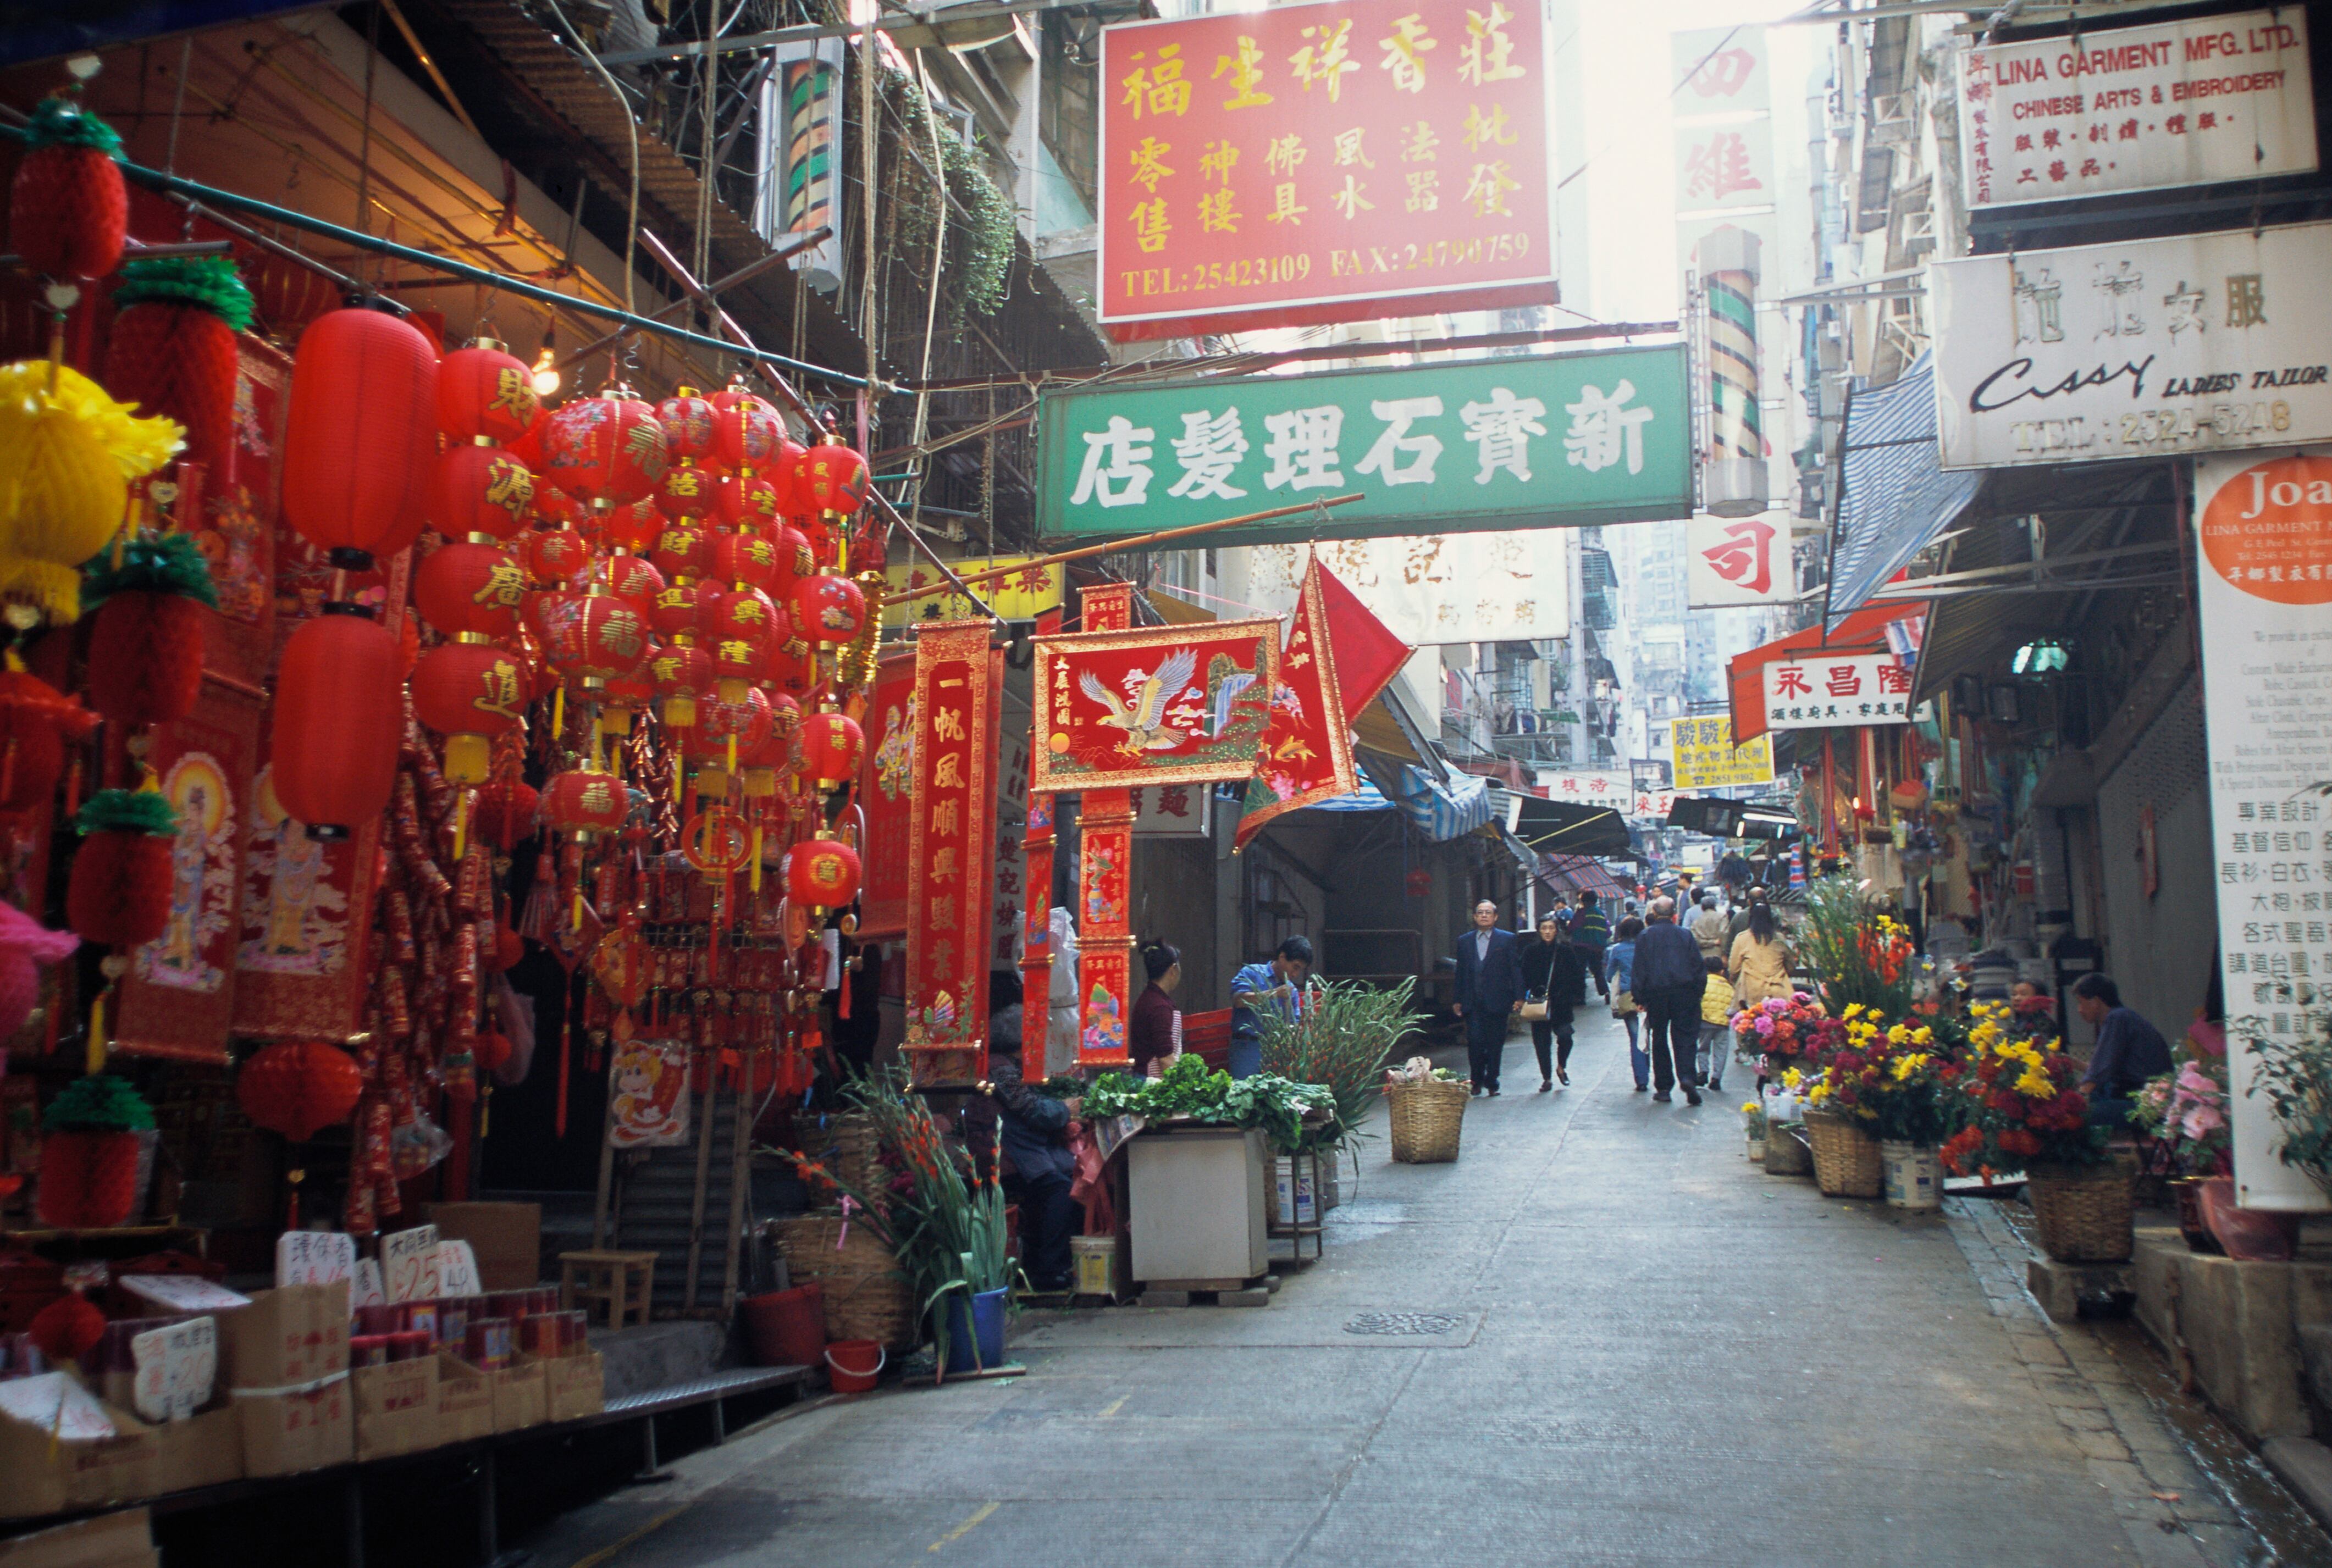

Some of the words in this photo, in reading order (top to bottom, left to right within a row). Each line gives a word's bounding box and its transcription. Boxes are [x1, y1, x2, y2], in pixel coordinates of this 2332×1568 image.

[1121, 1, 1527, 119] 福生祥香莊
[1996, 57, 2048, 86] LINA
[2057, 41, 2172, 78] GARMENT
[2185, 31, 2243, 62] MFG.
[2250, 25, 2301, 53] LTD.
[2013, 95, 2084, 120] CHINESE
[2095, 87, 2141, 110] ARTS
[2151, 87, 2163, 103] &
[2172, 70, 2285, 101] EMBROIDERY
[1129, 136, 1174, 253] 零售
[1197, 139, 1243, 233] 神樓
[1264, 132, 1308, 225] 佛具
[1330, 127, 1375, 219] 風水
[1461, 103, 1522, 218] 批發
[2162, 372, 2241, 398] LADIES
[2252, 366, 2328, 389] TAILOR
[1070, 378, 1654, 508] 新寶石理髮店
